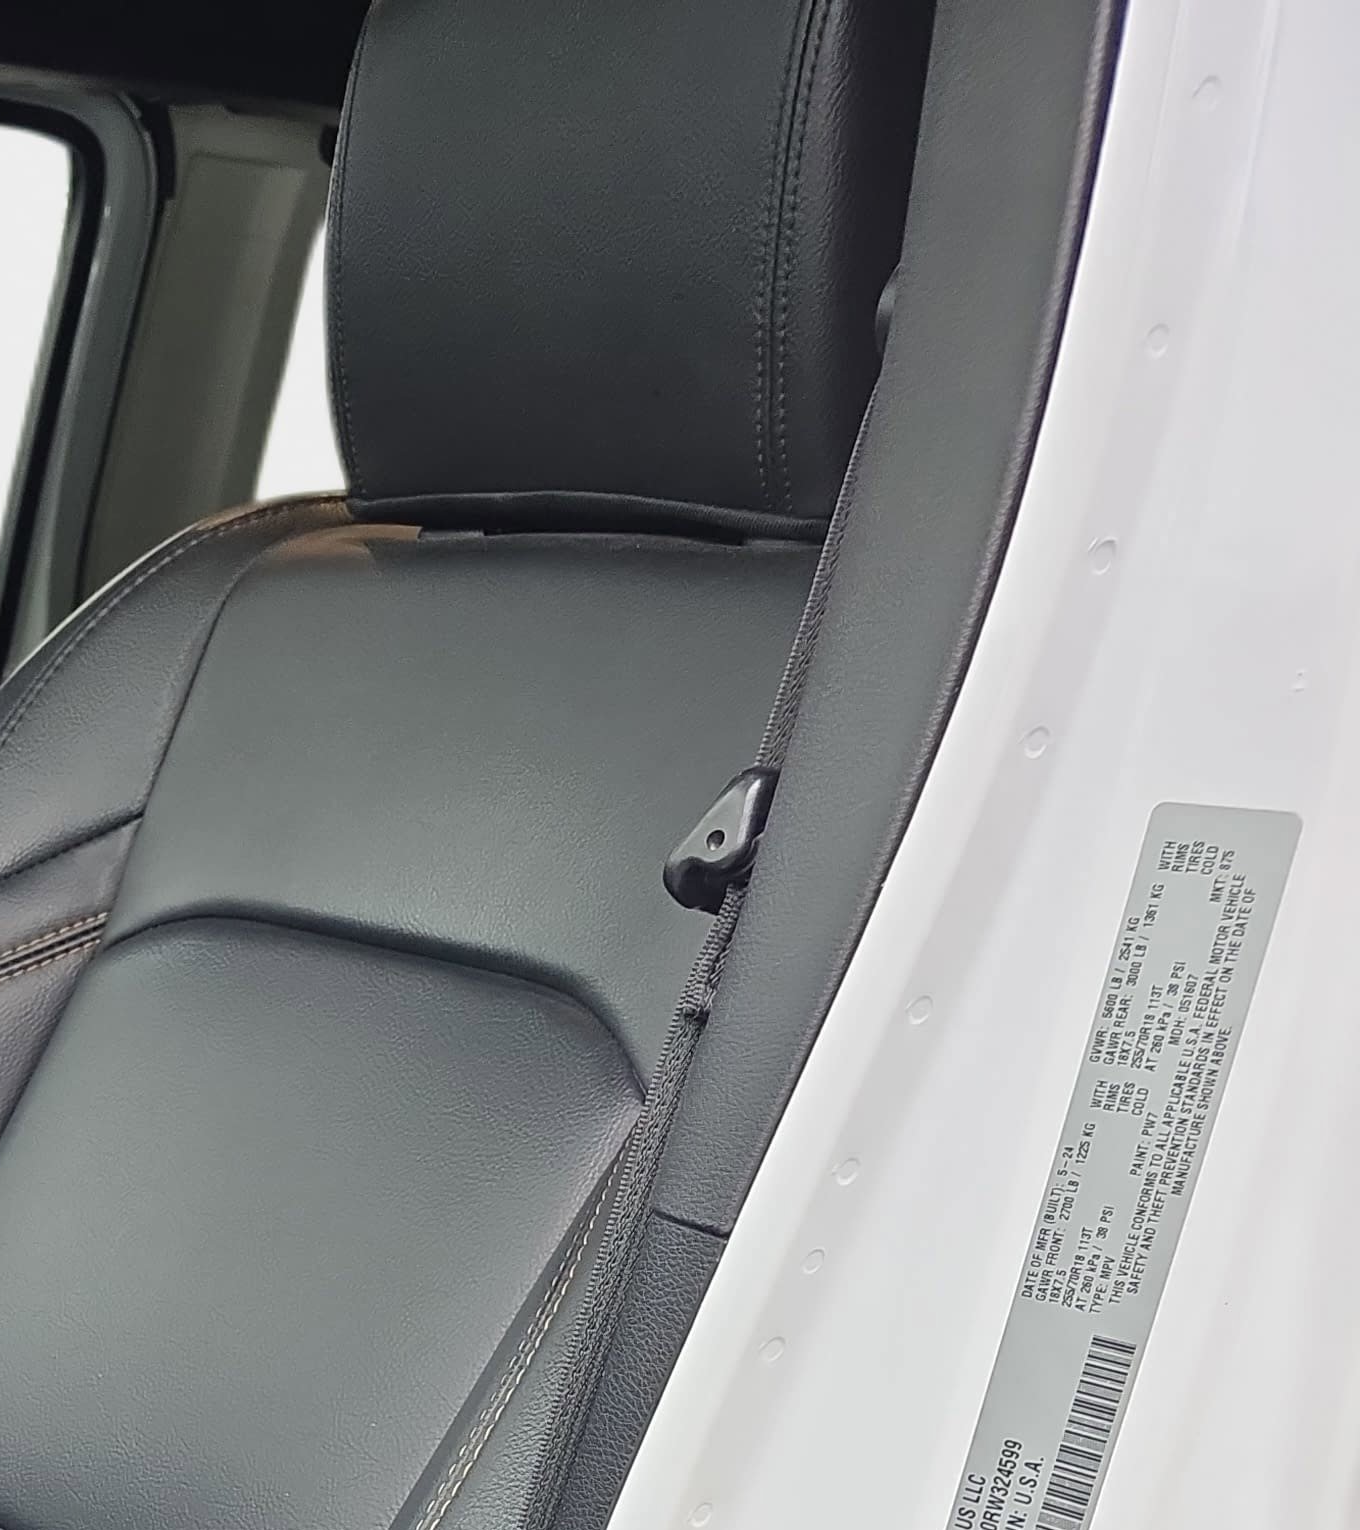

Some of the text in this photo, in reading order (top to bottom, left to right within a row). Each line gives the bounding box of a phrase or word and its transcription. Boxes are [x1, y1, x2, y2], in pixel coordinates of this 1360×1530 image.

[1156, 840, 1178, 871] WITH
[1149, 883, 1165, 900] KG
[1125, 916, 1141, 933] KG
[1142, 903, 1160, 928] 1361
[1116, 843, 1191, 1066] 18X7.5 RIMS
[1117, 936, 1135, 962] 2541
[1129, 840, 1206, 1070] 255/70R18 113T TIRES
[1132, 944, 1148, 958] LB
[1143, 845, 1220, 1073] AT 260 kPa 38 PSI COLD
[1108, 976, 1123, 990] LB
[1125, 961, 1143, 987] 3000
[1101, 993, 1119, 1019] 5600
[1112, 993, 1134, 1029] REAR:
[1088, 1025, 1110, 1063] GVWR:
[1102, 1031, 1123, 1065] GAWR
[1087, 850, 1236, 1314] TYPE: MPV PAINT: PW7 MDH: 051607 MKT: 875
[1089, 1079, 1109, 1108] WITH
[1107, 873, 1247, 1304] THIS VEHICLE CONFORMS TO ALL APPLICABLE U.S.A. FEDERAL MOTOR VEHICLE
[1126, 887, 1257, 1295] SAFETY AND THEFT PREVENTION STANDARDS IN EFFECT ON THE DATE OF
[1170, 1025, 1233, 1197] MANUFACTURE SHOWN ABOVE.
[1081, 1122, 1096, 1138] KG
[1074, 1140, 1091, 1164] 1225
[1048, 1083, 1121, 1303] 18X7.5 RIMS
[1060, 1081, 1136, 1308] 255/70R18 113T TIRES
[1063, 1179, 1080, 1194] LB
[1074, 1087, 1150, 1312] AT 260 kPa 38 PSI COLD
[1042, 1182, 1066, 1225] (BUILT):
[1058, 1196, 1075, 1221] 2700
[1034, 1227, 1052, 1252] MFR
[1044, 1227, 1067, 1266] FRONT:
[1030, 1253, 1043, 1268] OF
[1020, 1270, 1040, 1299] DATE
[1034, 1269, 1055, 1302] GAWR
[962, 1473, 987, 1504] LLC
[1013, 1457, 1045, 1505] U.S.A.
[954, 1506, 977, 1530] US
